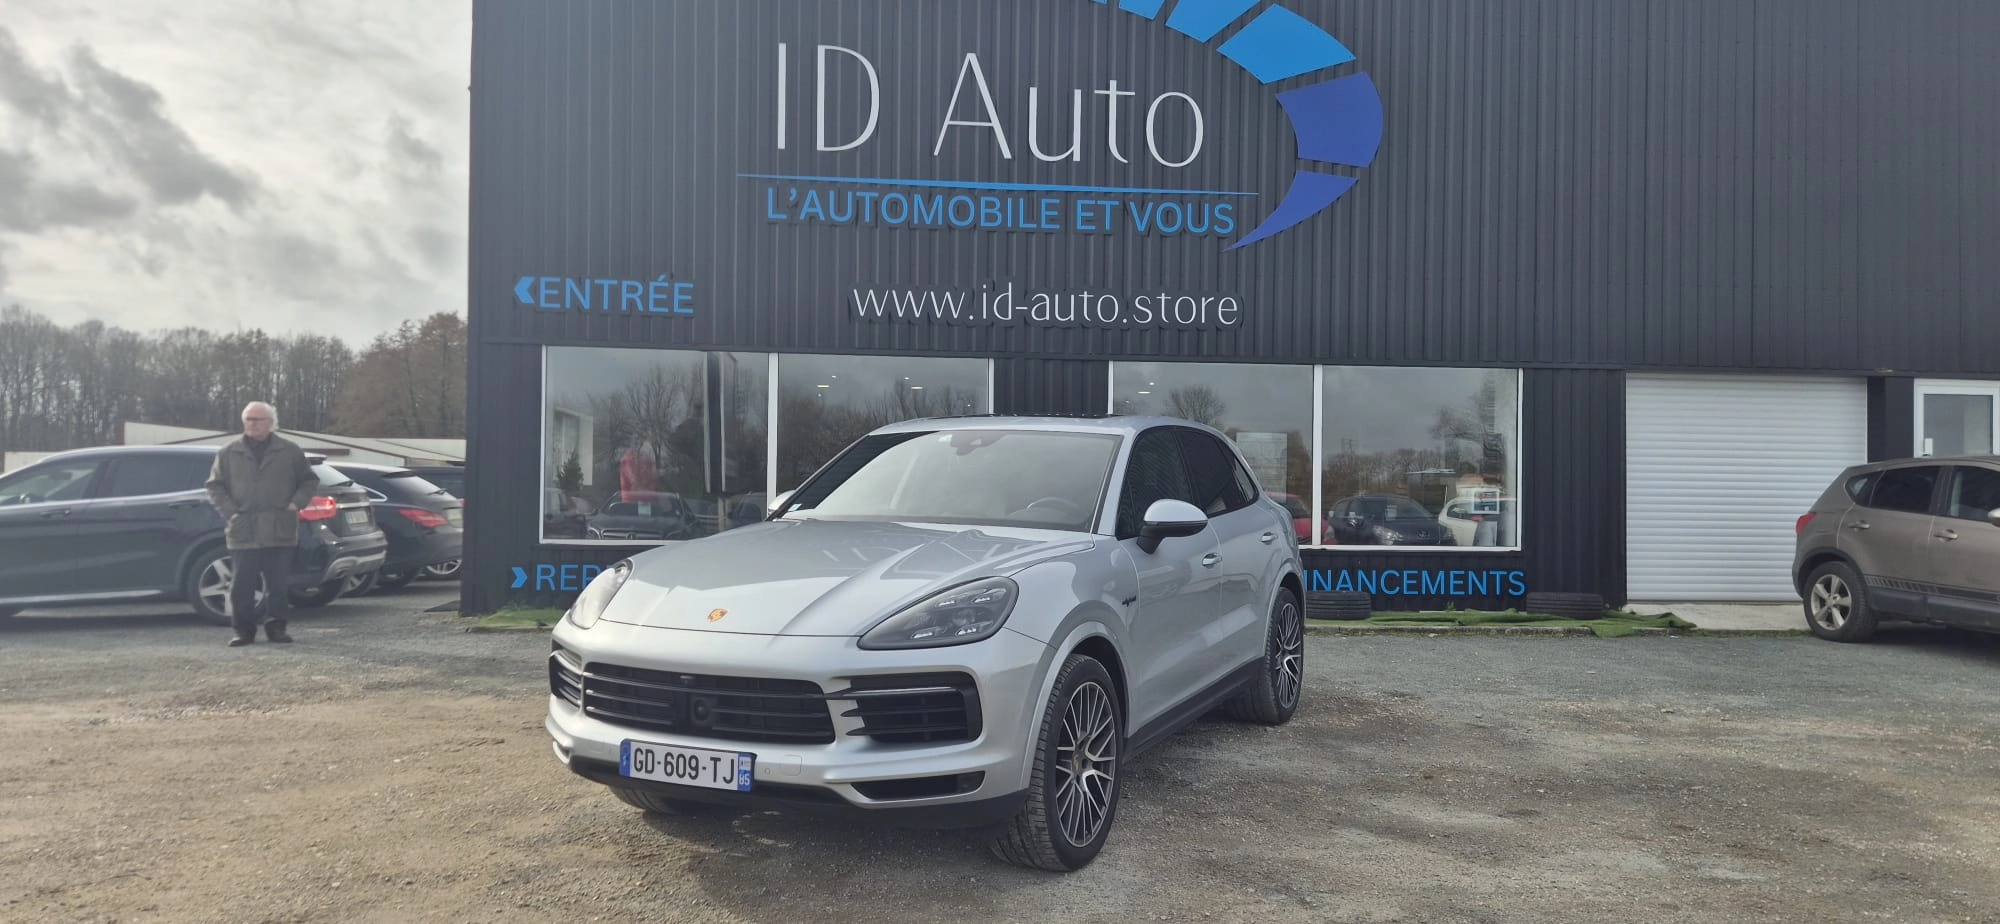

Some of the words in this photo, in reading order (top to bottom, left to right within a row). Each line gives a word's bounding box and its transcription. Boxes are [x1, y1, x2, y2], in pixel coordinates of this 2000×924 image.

[777, 43, 880, 151] ID
[933, 53, 1204, 167] Auto
[766, 188, 1060, 230] L’AUTOMOBILE
[1076, 199, 1119, 232] ET
[1129, 201, 1235, 234] VOUS
[539, 274, 694, 314] ENTRÉE
[853, 282, 1238, 325] www.id-auto.store
[1303, 569, 1526, 596] INANCEMENTS
[634, 747, 734, 784] GD-609-TJ
